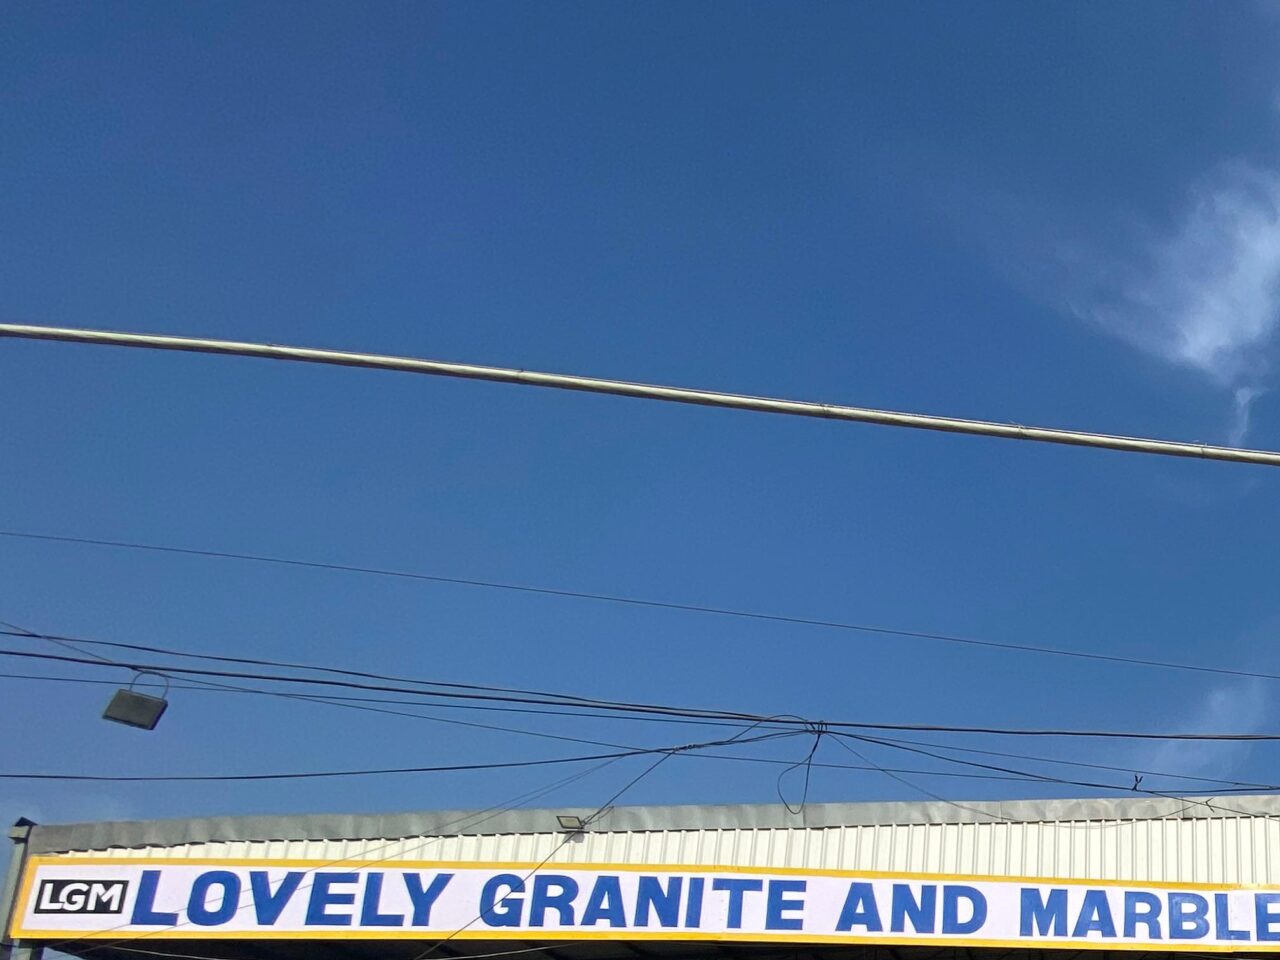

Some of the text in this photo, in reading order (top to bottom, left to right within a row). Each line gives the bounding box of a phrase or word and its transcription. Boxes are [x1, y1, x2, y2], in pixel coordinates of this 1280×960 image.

[41, 881, 122, 913] LGM
[130, 869, 455, 927] LOVELY
[479, 873, 803, 932] GRANITE
[835, 882, 988, 937] AND
